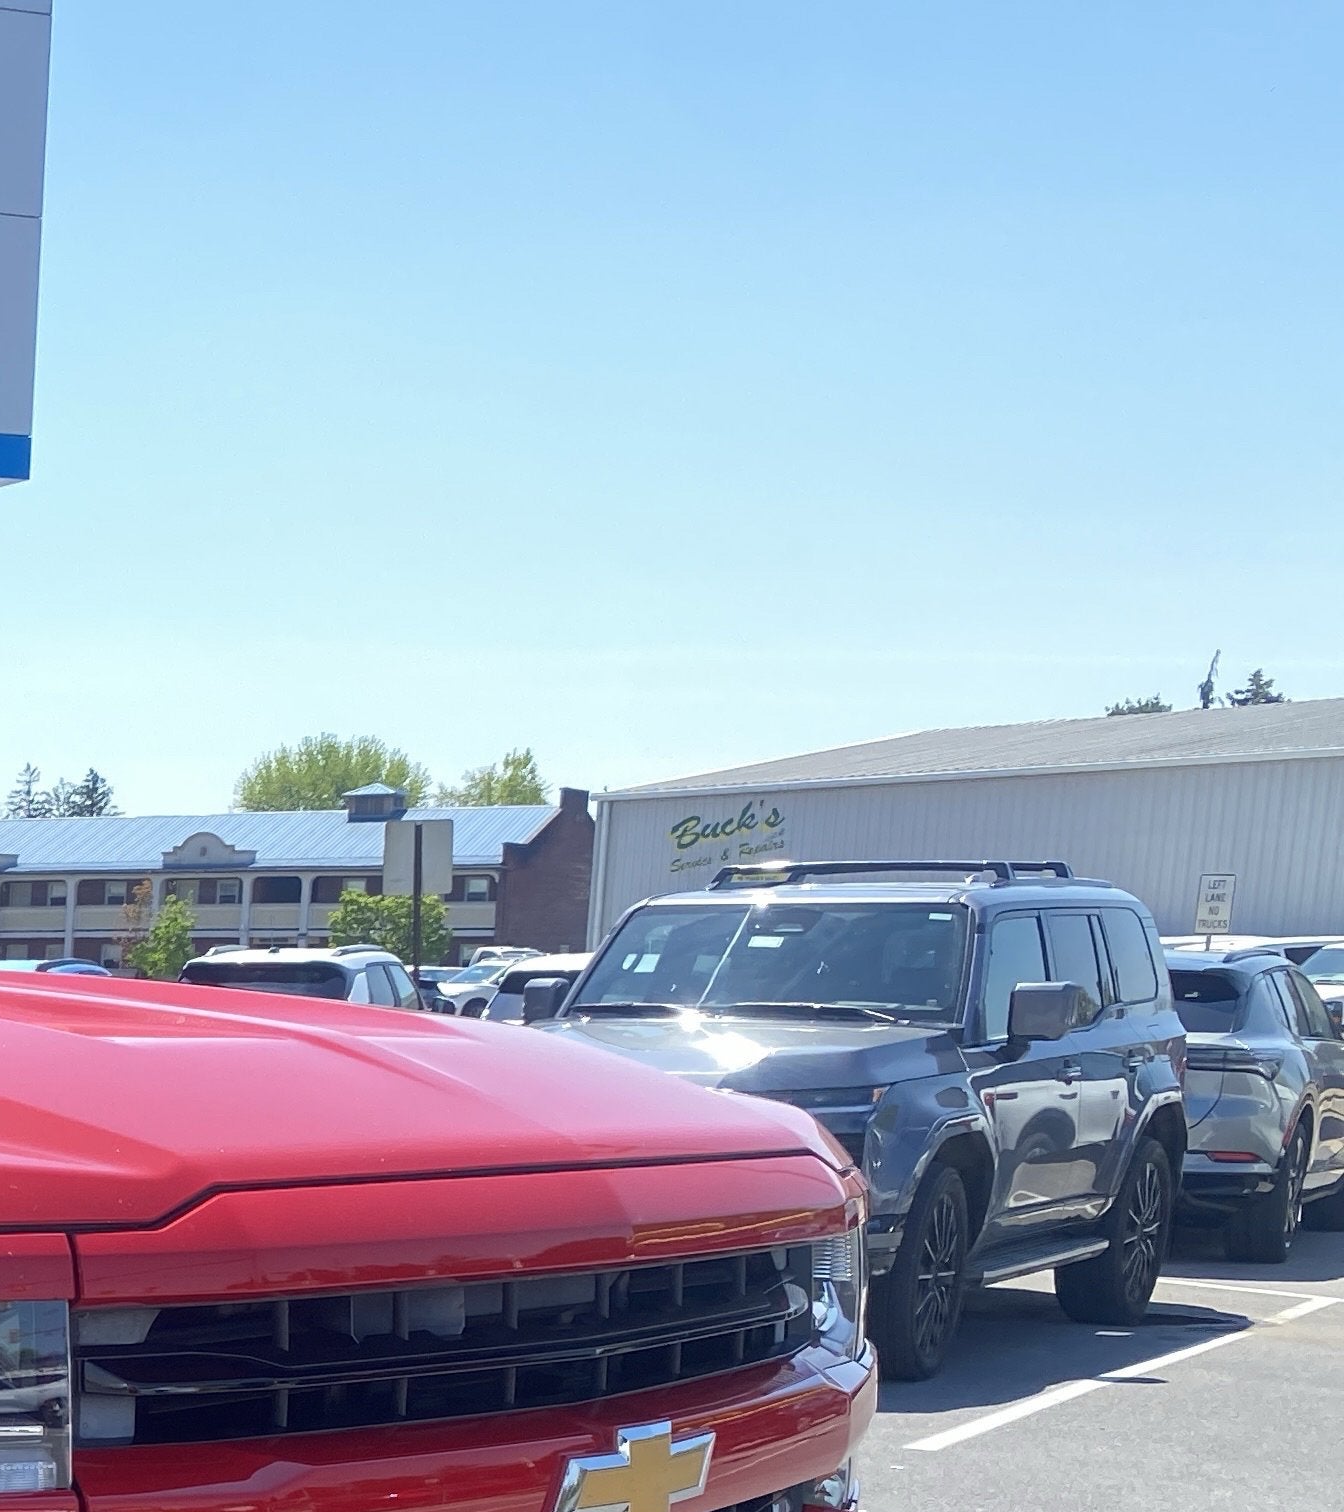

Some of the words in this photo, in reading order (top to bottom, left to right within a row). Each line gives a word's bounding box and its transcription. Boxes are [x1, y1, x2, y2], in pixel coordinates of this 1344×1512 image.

[670, 800, 785, 849] Buck's
[1208, 879, 1227, 890] LEFT
[1205, 892, 1227, 903] LANE
[1208, 905, 1220, 916] NO
[1198, 919, 1228, 929] TRUCKS
